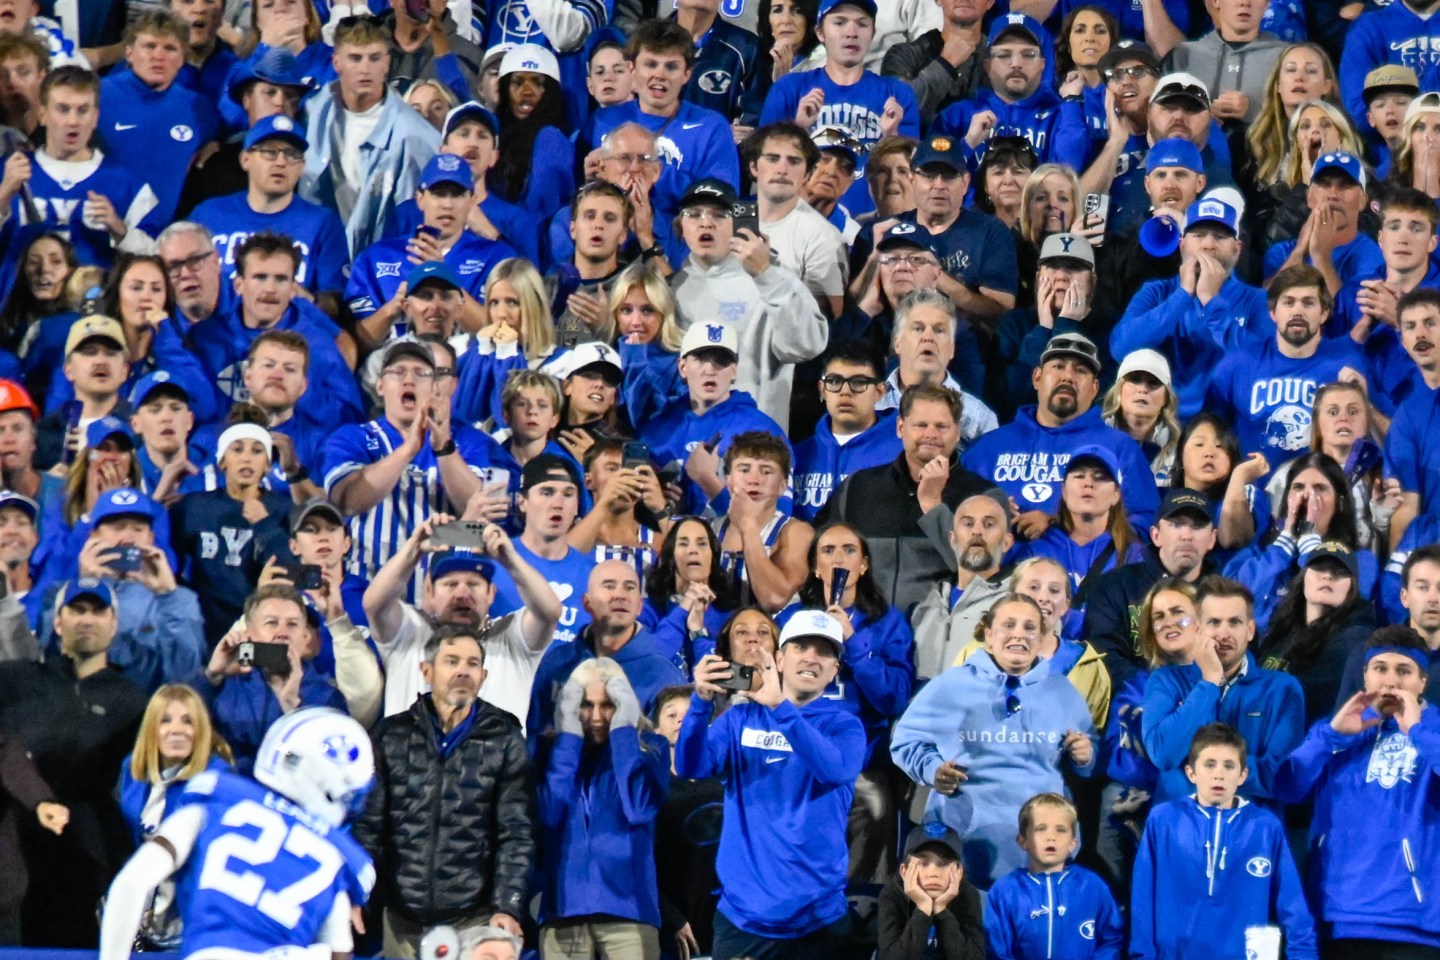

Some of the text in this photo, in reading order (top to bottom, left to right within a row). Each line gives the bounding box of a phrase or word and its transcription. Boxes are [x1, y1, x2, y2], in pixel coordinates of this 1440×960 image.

[814, 102, 883, 140] OUGS
[1059, 236, 1075, 253] Y
[993, 464, 1066, 482] COUGA
[1028, 485, 1048, 501] Y
[198, 799, 342, 931] 27
[1251, 859, 1268, 875] Y
